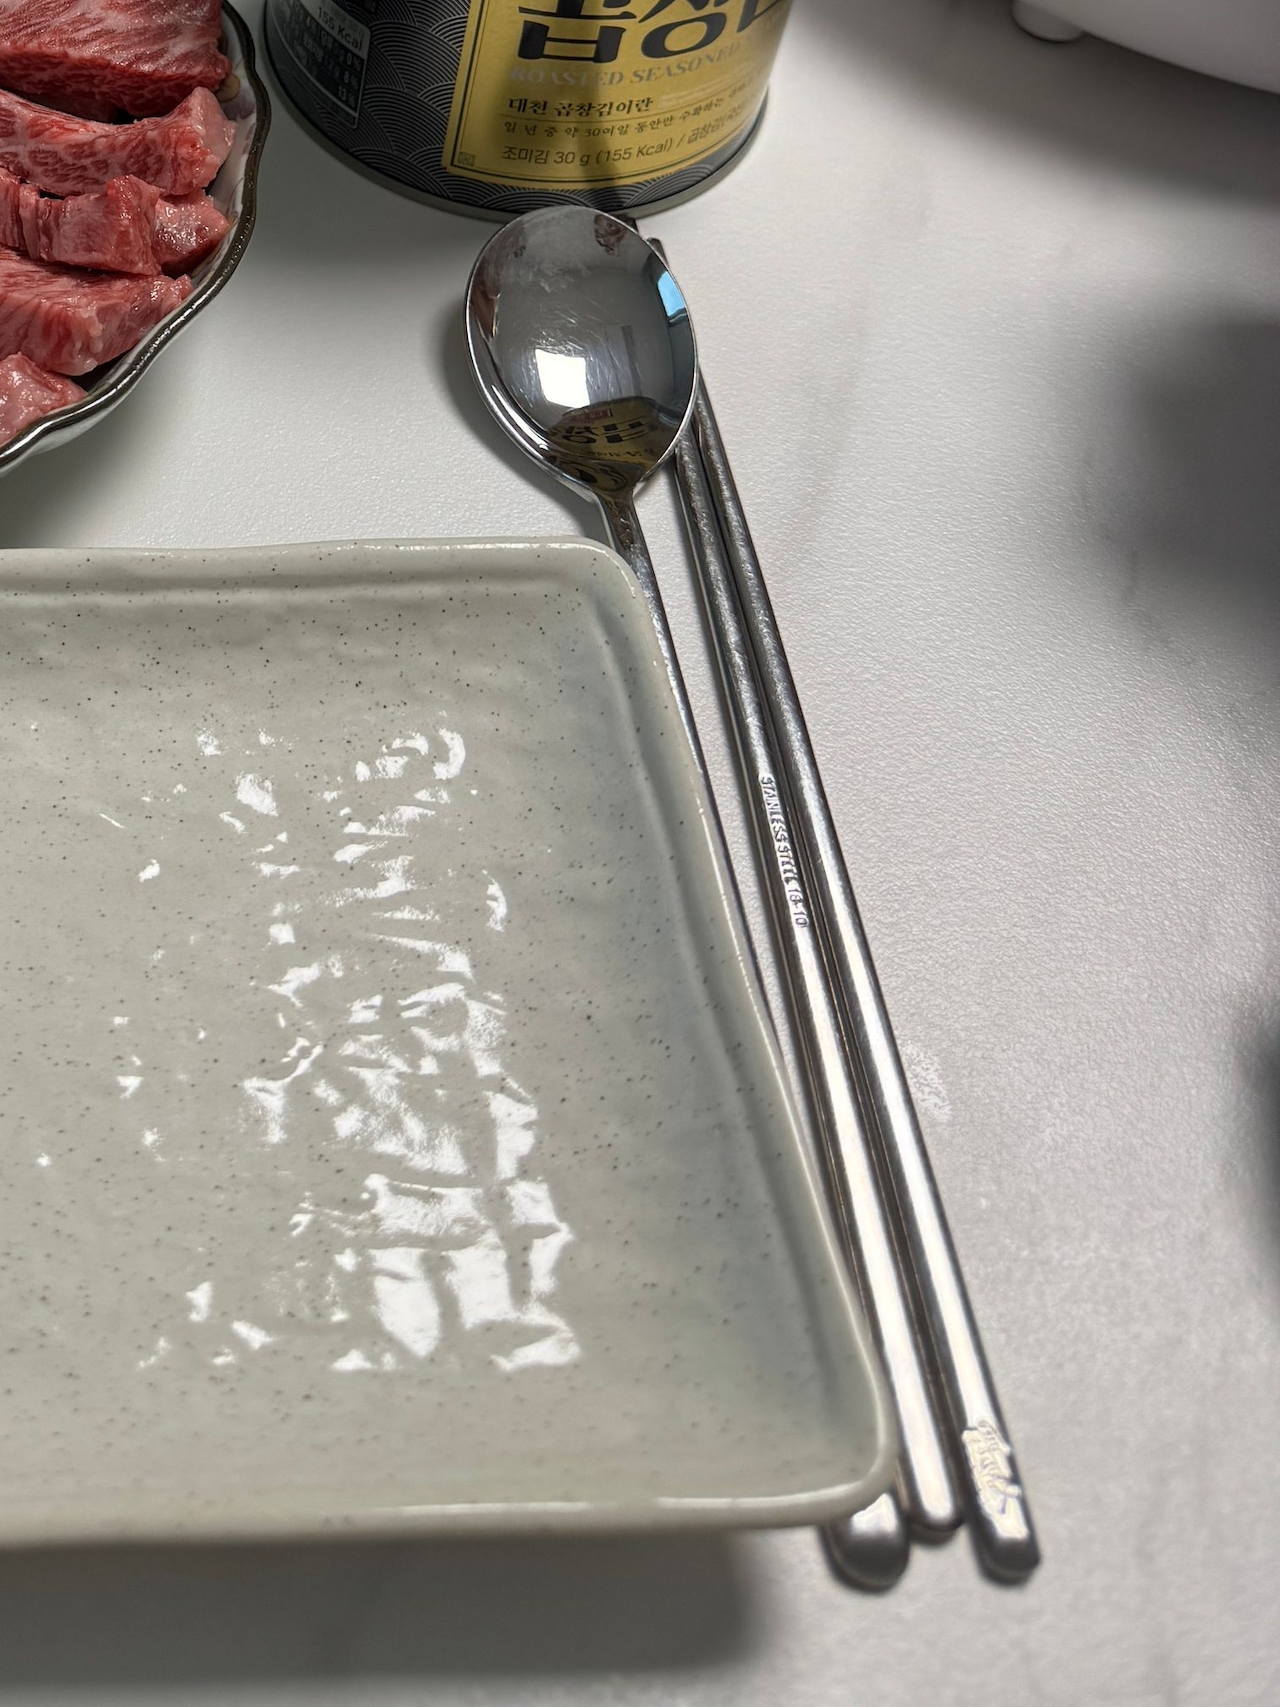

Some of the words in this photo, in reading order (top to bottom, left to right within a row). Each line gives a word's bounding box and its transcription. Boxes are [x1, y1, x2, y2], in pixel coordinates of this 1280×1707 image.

[318, 6, 335, 30] 155
[337, 24, 363, 51] Kcal
[509, 63, 625, 88] ROASTED
[630, 41, 742, 84] SEASONED
[508, 98, 548, 116] 대천
[554, 96, 654, 117] 곱창김이란
[523, 124, 537, 136] 년
[544, 125, 558, 138] 중
[565, 125, 578, 138] 약
[635, 114, 675, 134] 동안만
[501, 146, 549, 164] 조미김
[553, 146, 576, 164] 30
[579, 151, 590, 167] g
[595, 147, 632, 165] (155
[635, 136, 673, 159] Kcal)
[760, 776, 789, 842] STAINLESS
[777, 843, 798, 886] STEEL
